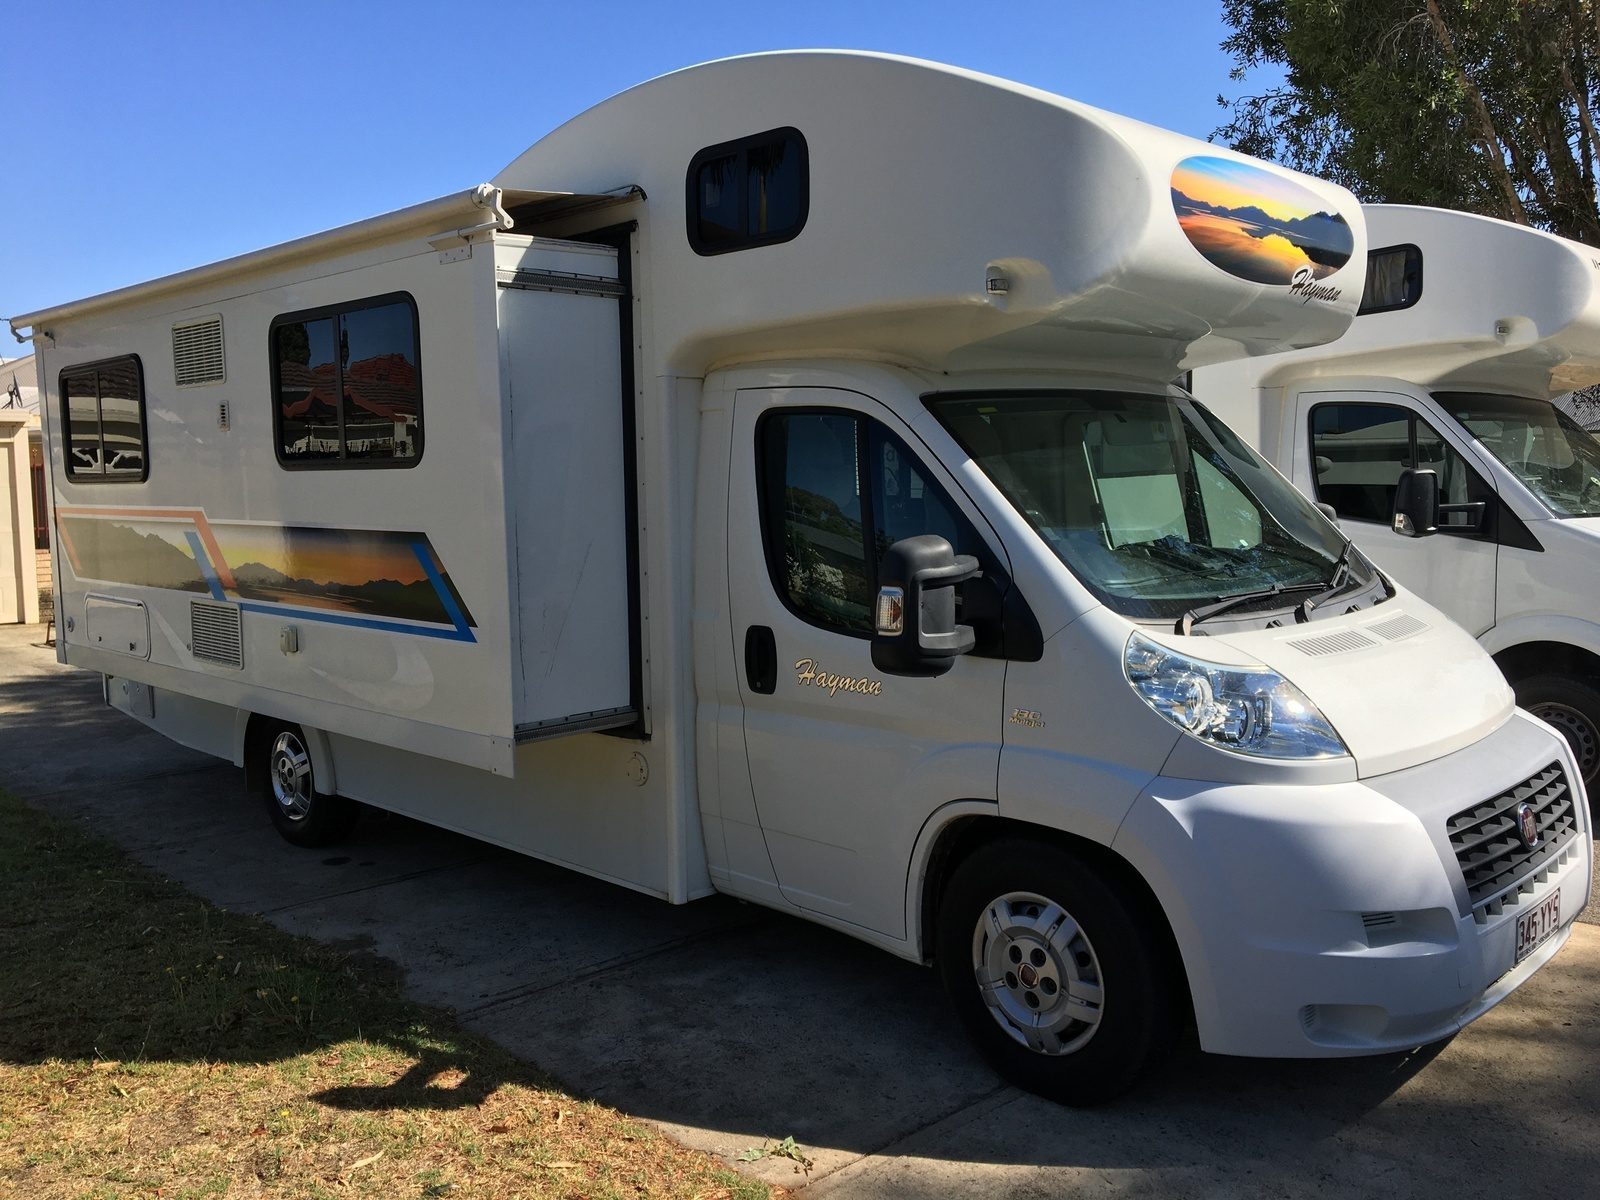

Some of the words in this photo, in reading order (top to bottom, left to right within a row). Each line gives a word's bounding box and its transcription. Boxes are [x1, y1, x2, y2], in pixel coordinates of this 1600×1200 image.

[1288, 267, 1342, 305] Hayman
[794, 657, 882, 698] Hayman
[1518, 911, 1538, 951] 345
